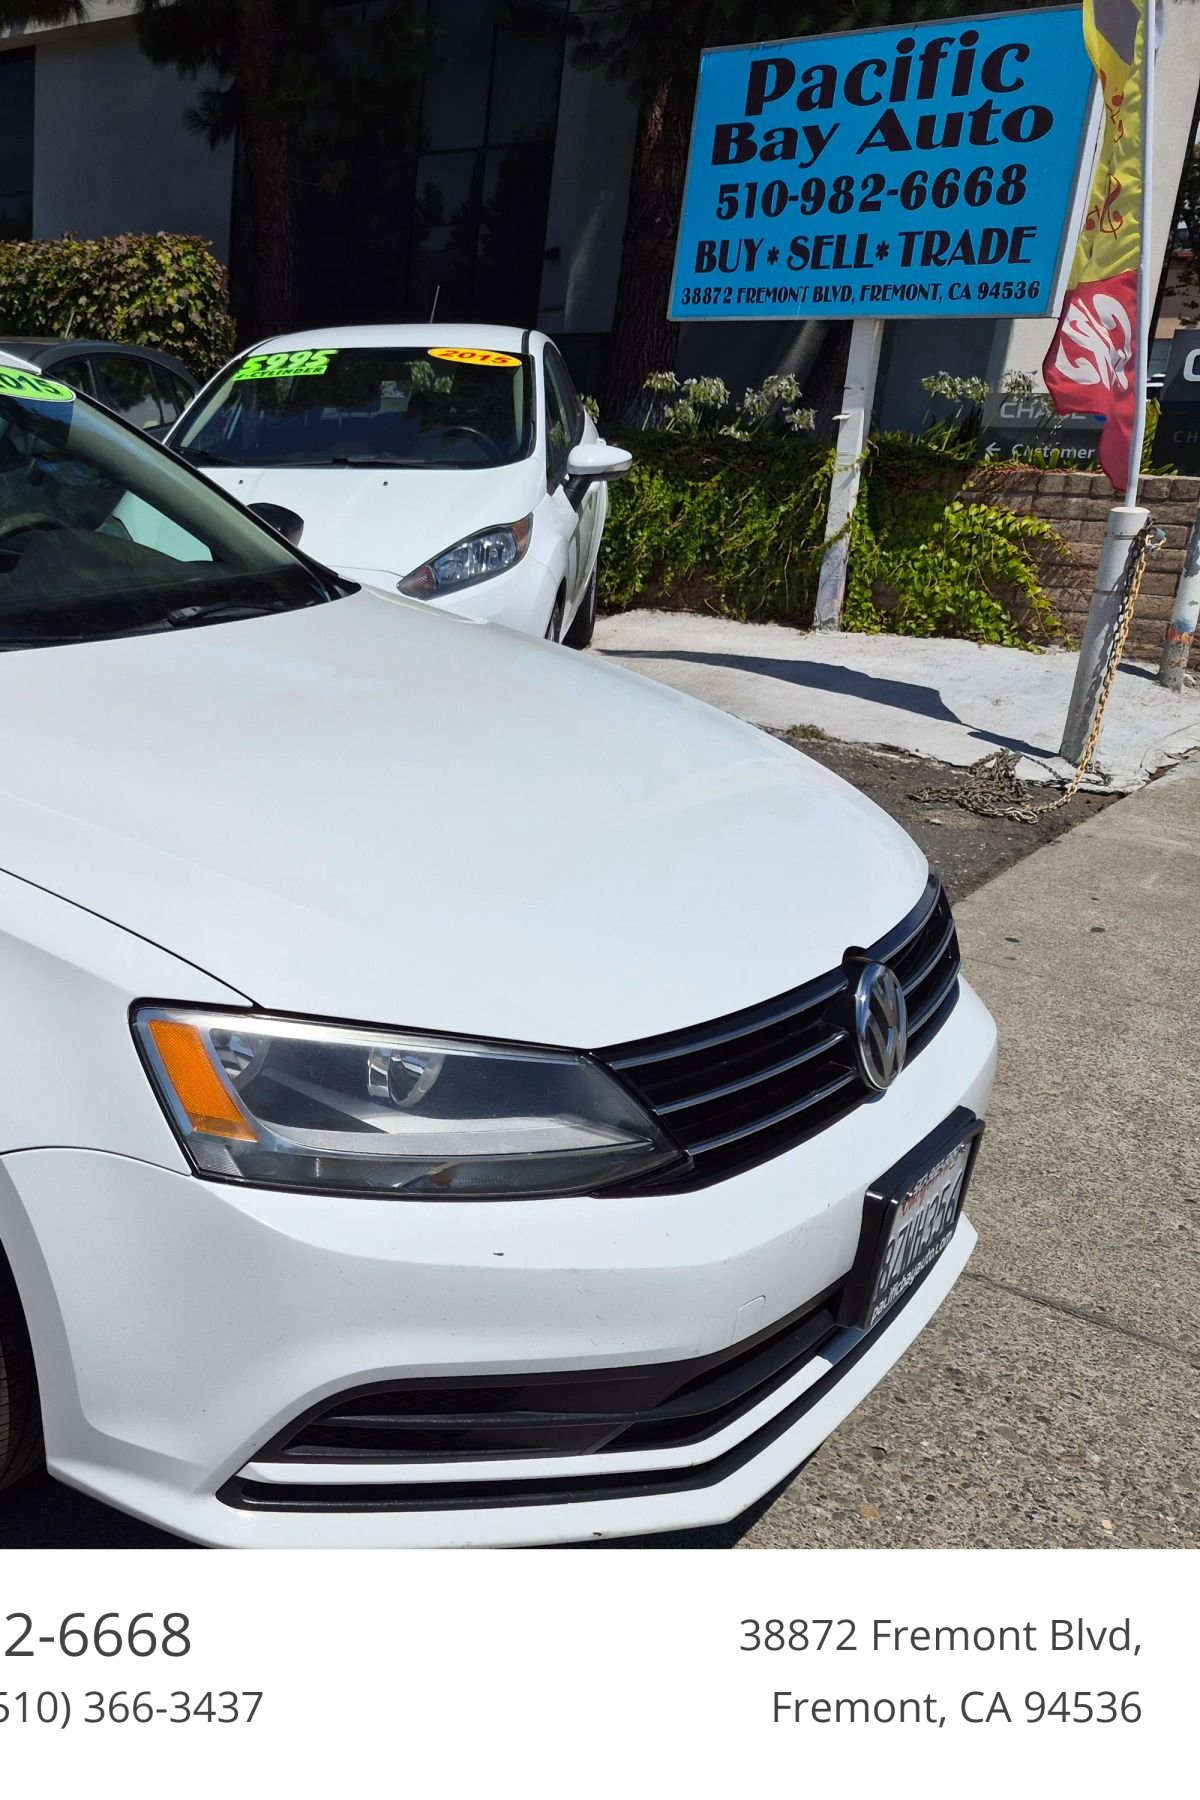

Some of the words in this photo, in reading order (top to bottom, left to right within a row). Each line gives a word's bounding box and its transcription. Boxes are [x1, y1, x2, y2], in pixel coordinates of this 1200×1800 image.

[745, 30, 1030, 116] Pacific
[711, 122, 840, 168] Bay
[855, 99, 1053, 155] Auto
[716, 163, 1027, 220] 510-982-6668
[695, 238, 764, 273] BUY
[787, 233, 873, 270] SELL
[898, 226, 1037, 267] TRADE
[681, 286, 733, 305] 38872
[736, 285, 810, 304] FREMONT
[813, 285, 854, 305] BLVD,
[859, 283, 943, 304] FREMONT,
[949, 283, 971, 300] CA
[977, 281, 1040, 300] 94536
[239, 349, 338, 373] 5995
[438, 350, 511, 363] 2015
